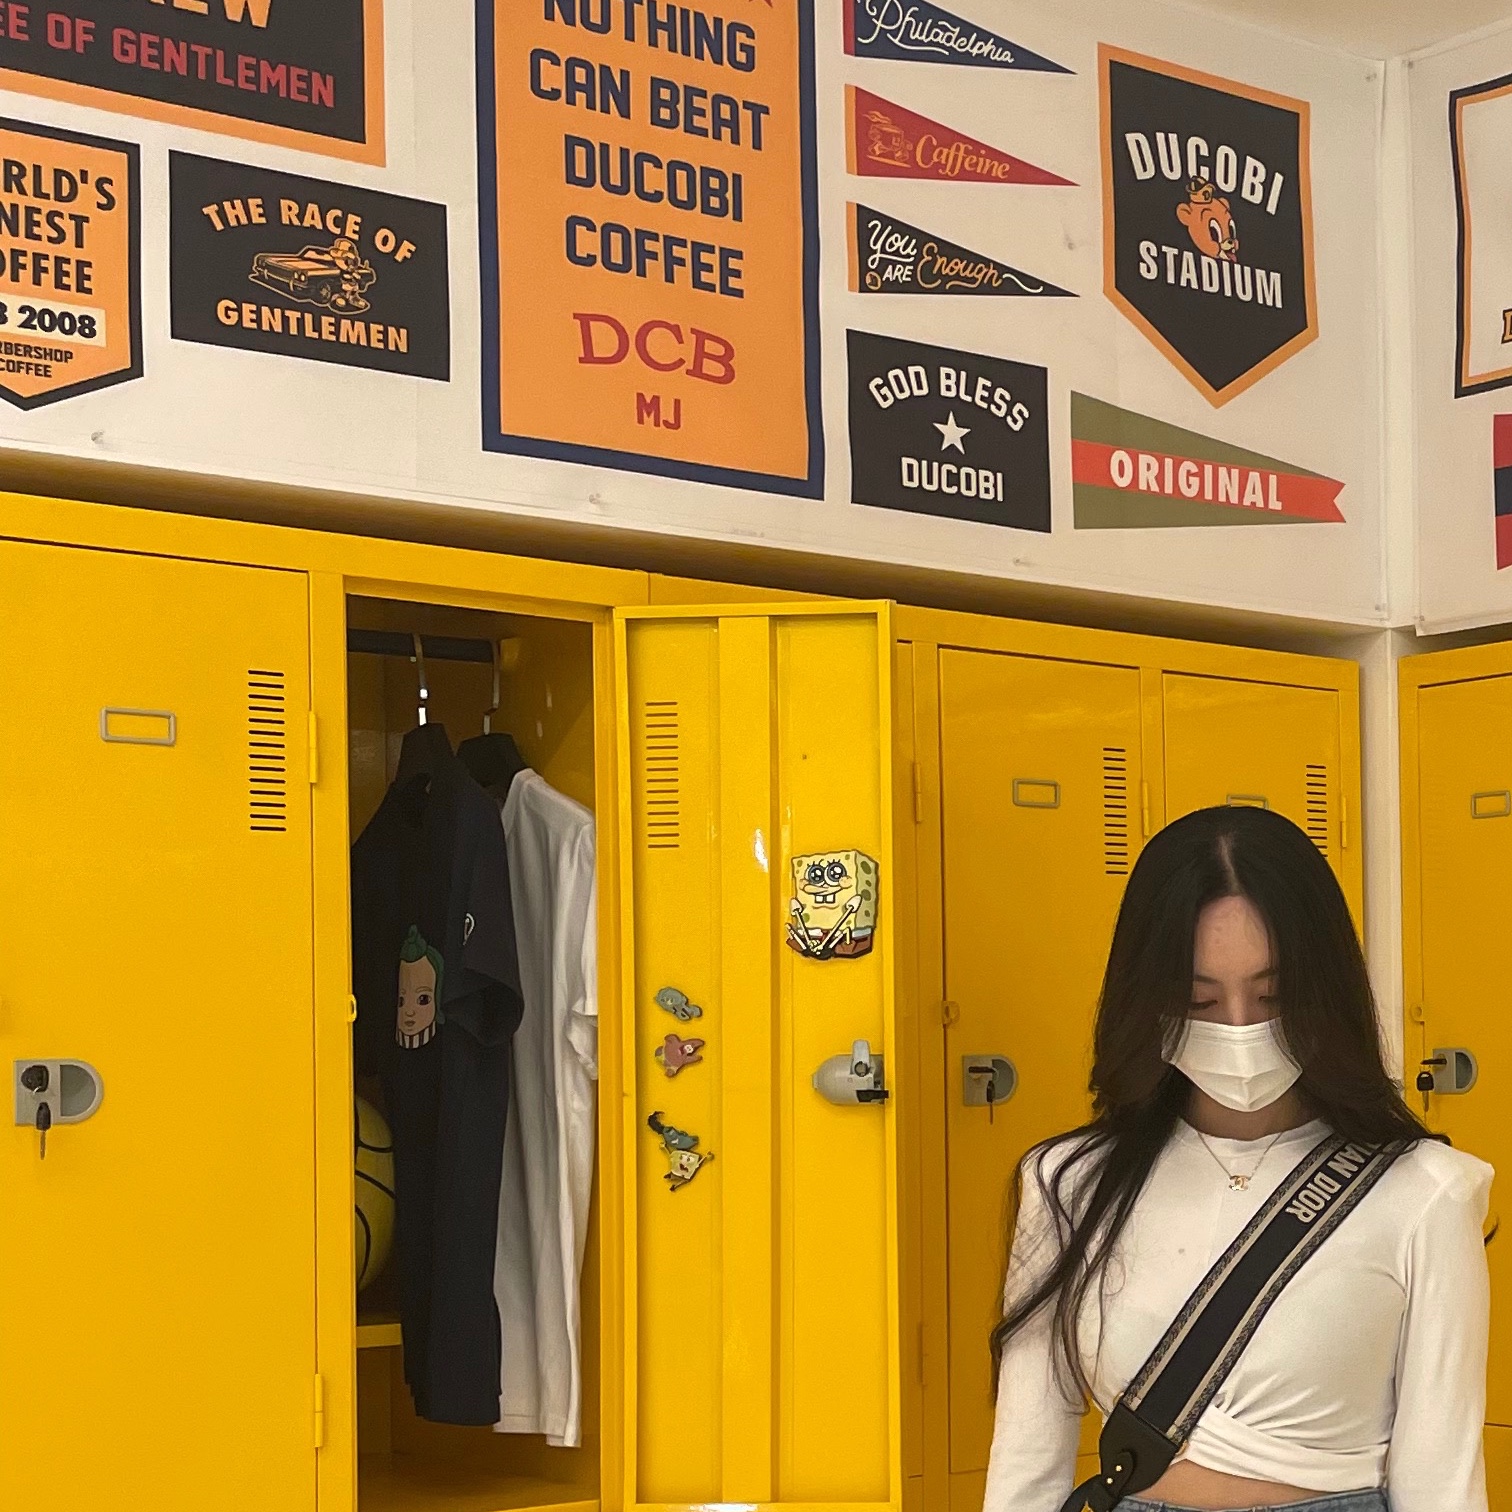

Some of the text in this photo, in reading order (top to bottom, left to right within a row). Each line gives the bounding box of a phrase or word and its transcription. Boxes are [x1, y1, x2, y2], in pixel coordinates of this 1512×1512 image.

[0, 0, 335, 108] E OF GENTLEMEN
[857, 0, 1015, 64] Philadelphia
[530, 48, 770, 151] CAN BEAT
[3, 157, 117, 212] RLD'S
[564, 133, 743, 223] DUCOBI
[915, 134, 1011, 179] Caffeine
[1124, 131, 1285, 216] DUCOBI
[202, 198, 417, 263] THE RACE OF
[565, 215, 745, 299] COFFEE
[867, 220, 918, 269] You
[882, 242, 1003, 290] ARE Enough
[1138, 240, 1284, 309] STADIUM
[0, 340, 73, 363] BERSHOP
[17, 304, 97, 339] 2008
[216, 299, 408, 353] GENTLEMEN
[573, 312, 736, 385] DCB
[636, 392, 681, 431] MJ
[868, 365, 1030, 432] GOD BLESS
[901, 456, 1004, 502] DUCOBI
[1110, 449, 1283, 512] ORIGINAL
[1285, 1171, 1342, 1223] DIOR
